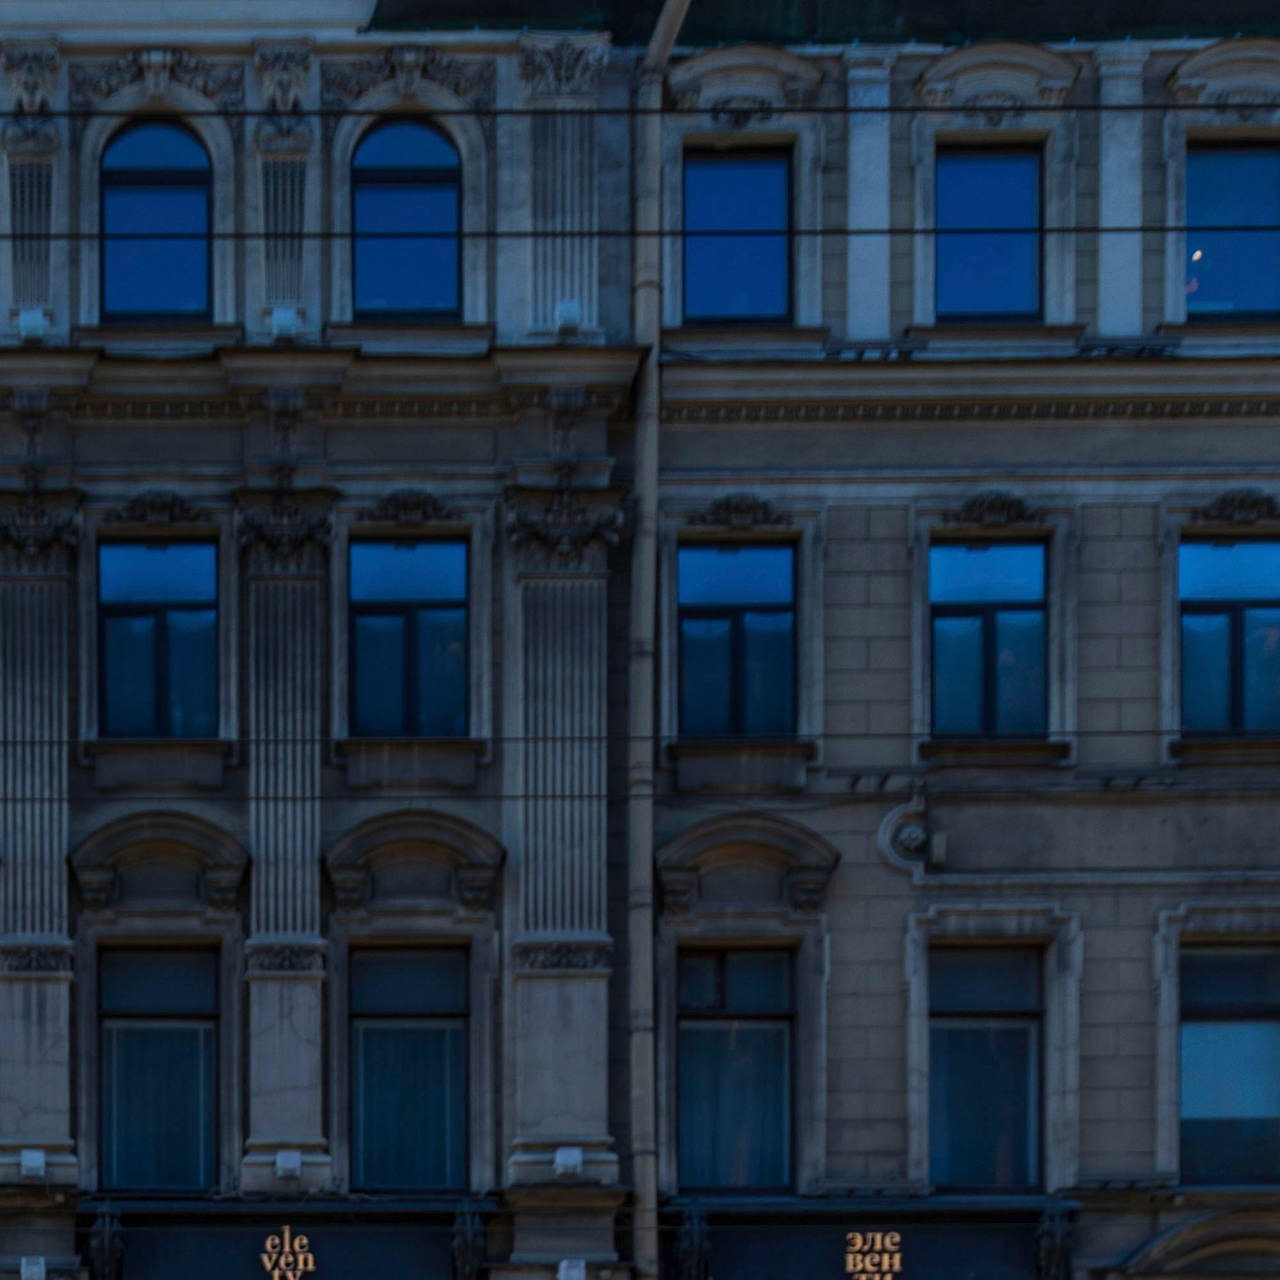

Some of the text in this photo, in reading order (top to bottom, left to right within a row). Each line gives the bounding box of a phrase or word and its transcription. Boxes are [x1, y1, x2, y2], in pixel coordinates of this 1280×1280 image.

[265, 1224, 309, 1254] ele
[846, 1231, 902, 1253] эле
[259, 1252, 317, 1272] ven
[844, 1252, 903, 1273] вен
